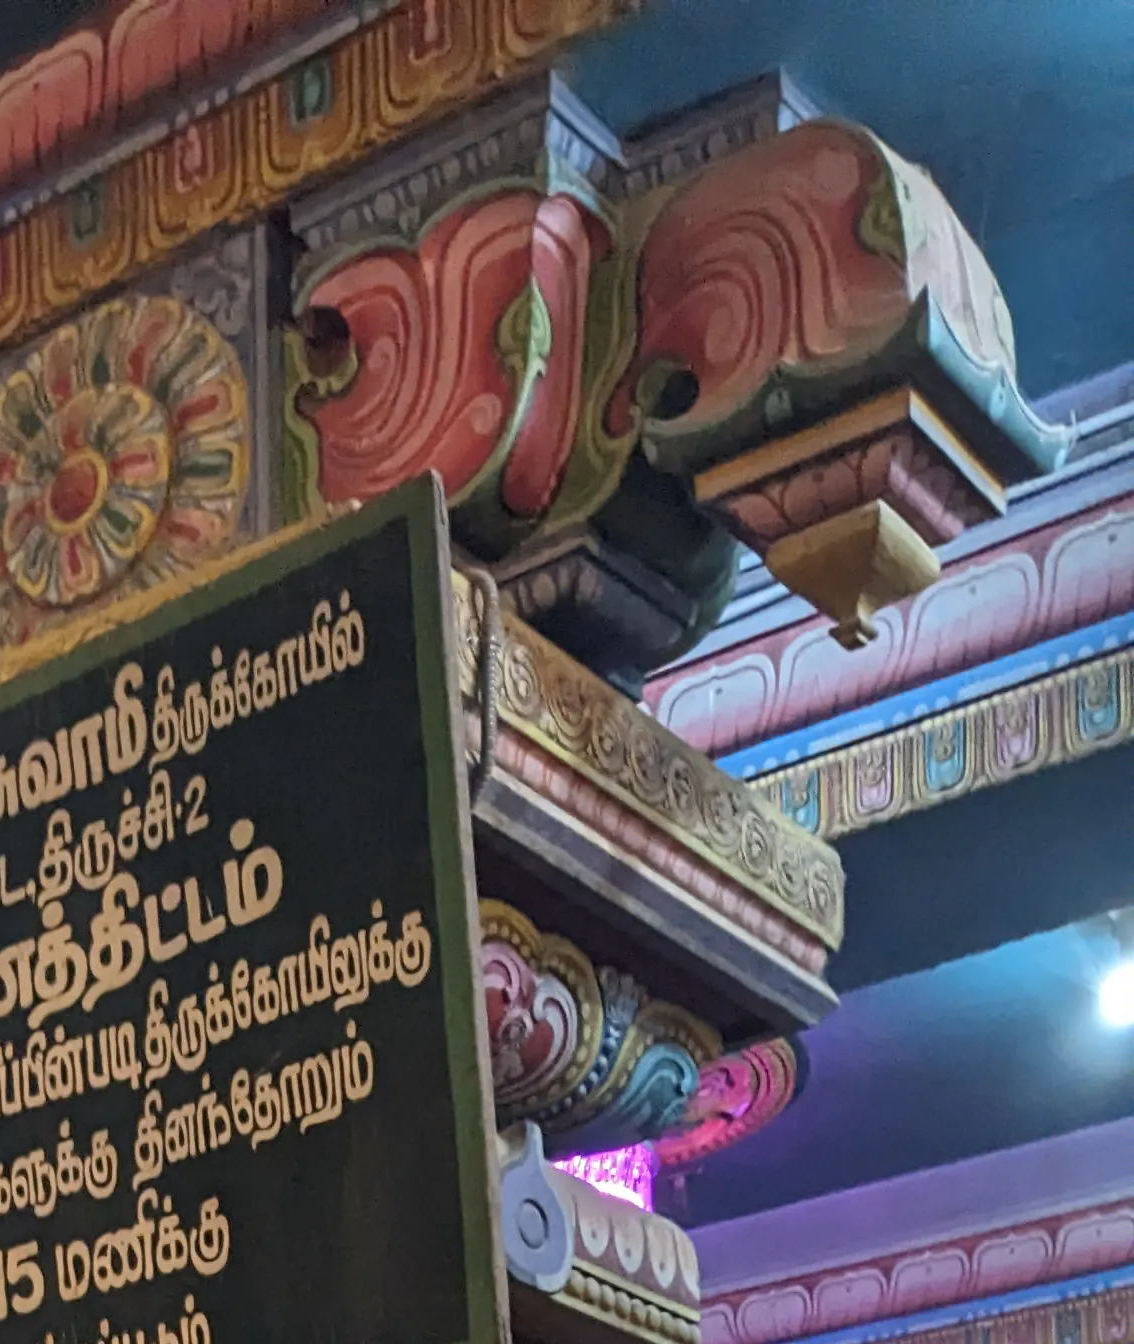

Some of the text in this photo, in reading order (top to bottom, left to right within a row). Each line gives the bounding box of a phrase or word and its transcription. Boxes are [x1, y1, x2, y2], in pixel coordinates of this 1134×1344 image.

[148, 590, 365, 774] திருக்கோயில்
[145, 899, 432, 1087] திருக்கோயிலுக்கு
[133, 1019, 374, 1191] தினந்தோறும்
[55, 1189, 231, 1302] மணிக்கு
